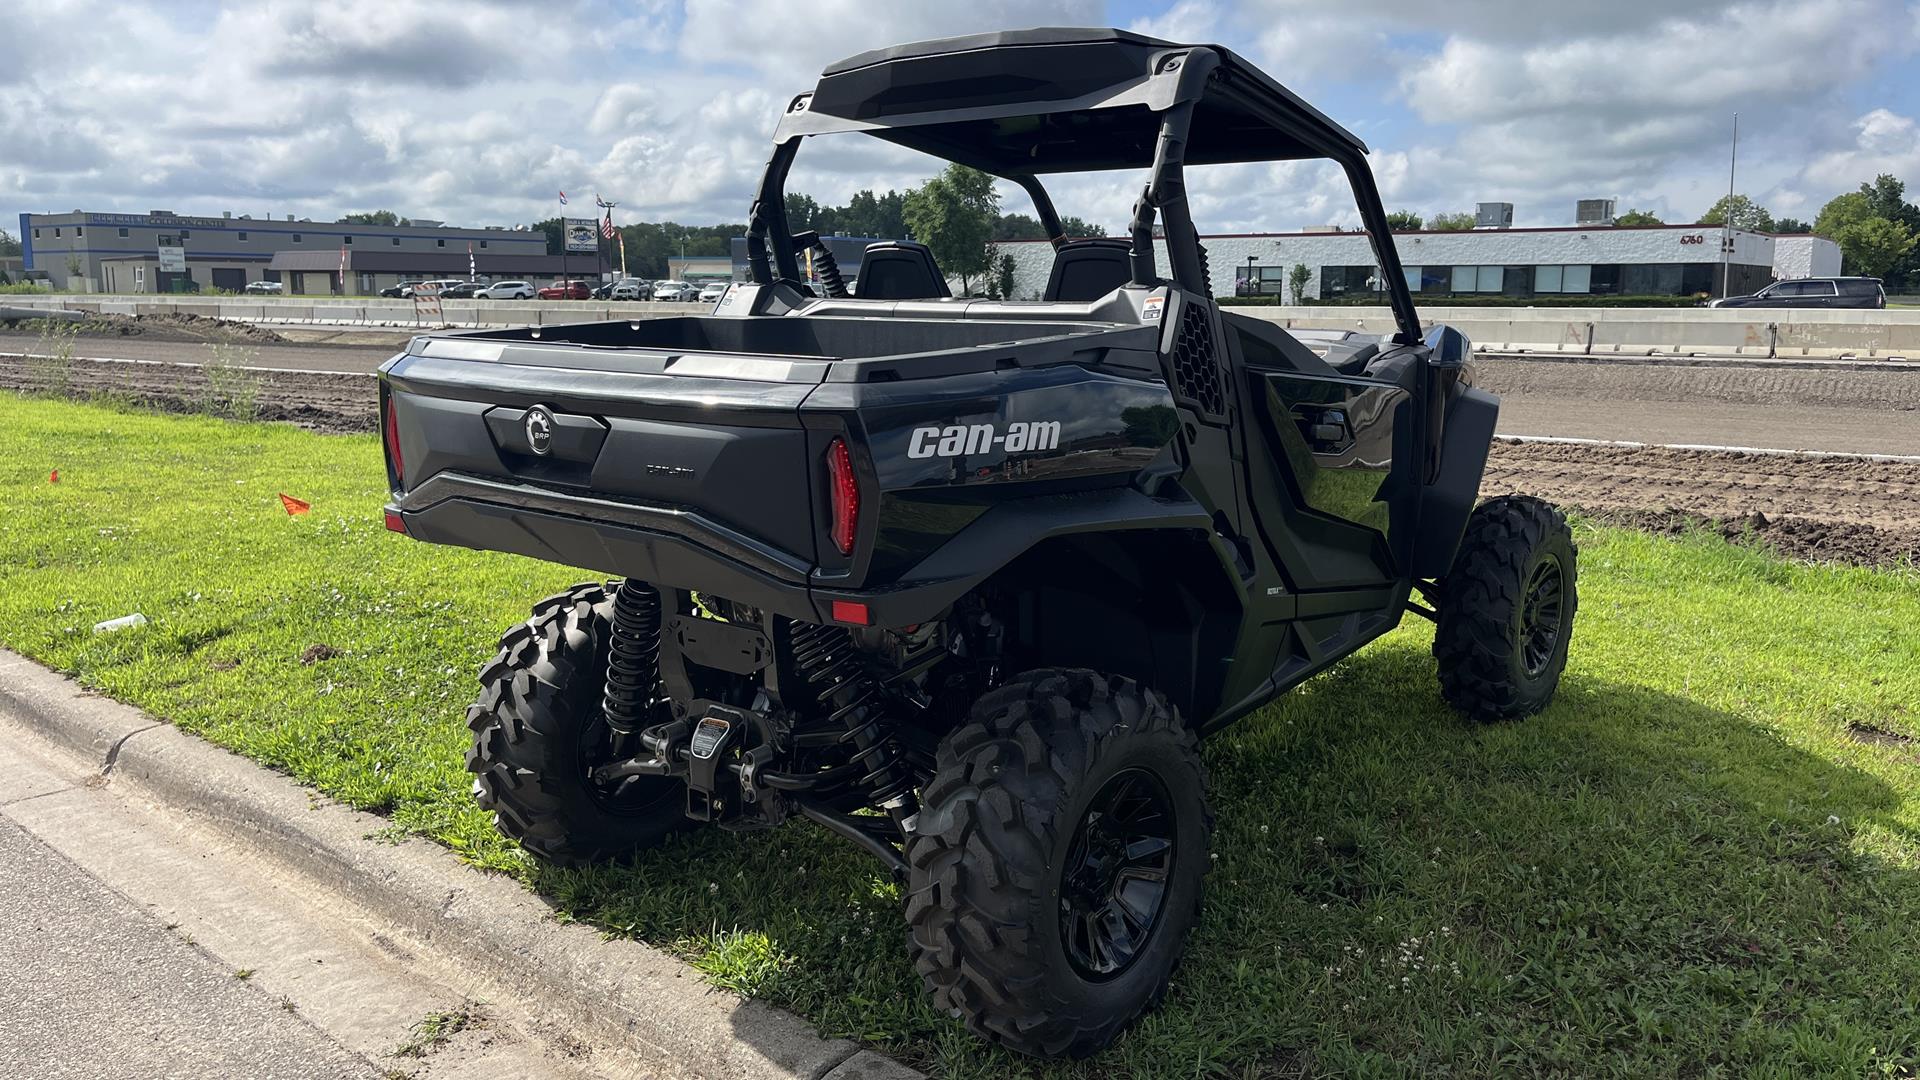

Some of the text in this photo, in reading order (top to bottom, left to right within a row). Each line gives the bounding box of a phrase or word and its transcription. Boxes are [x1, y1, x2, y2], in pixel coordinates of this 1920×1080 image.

[1680, 235, 1703, 245] 6760
[534, 432, 549, 440] BRP
[907, 420, 1061, 459] can-am
